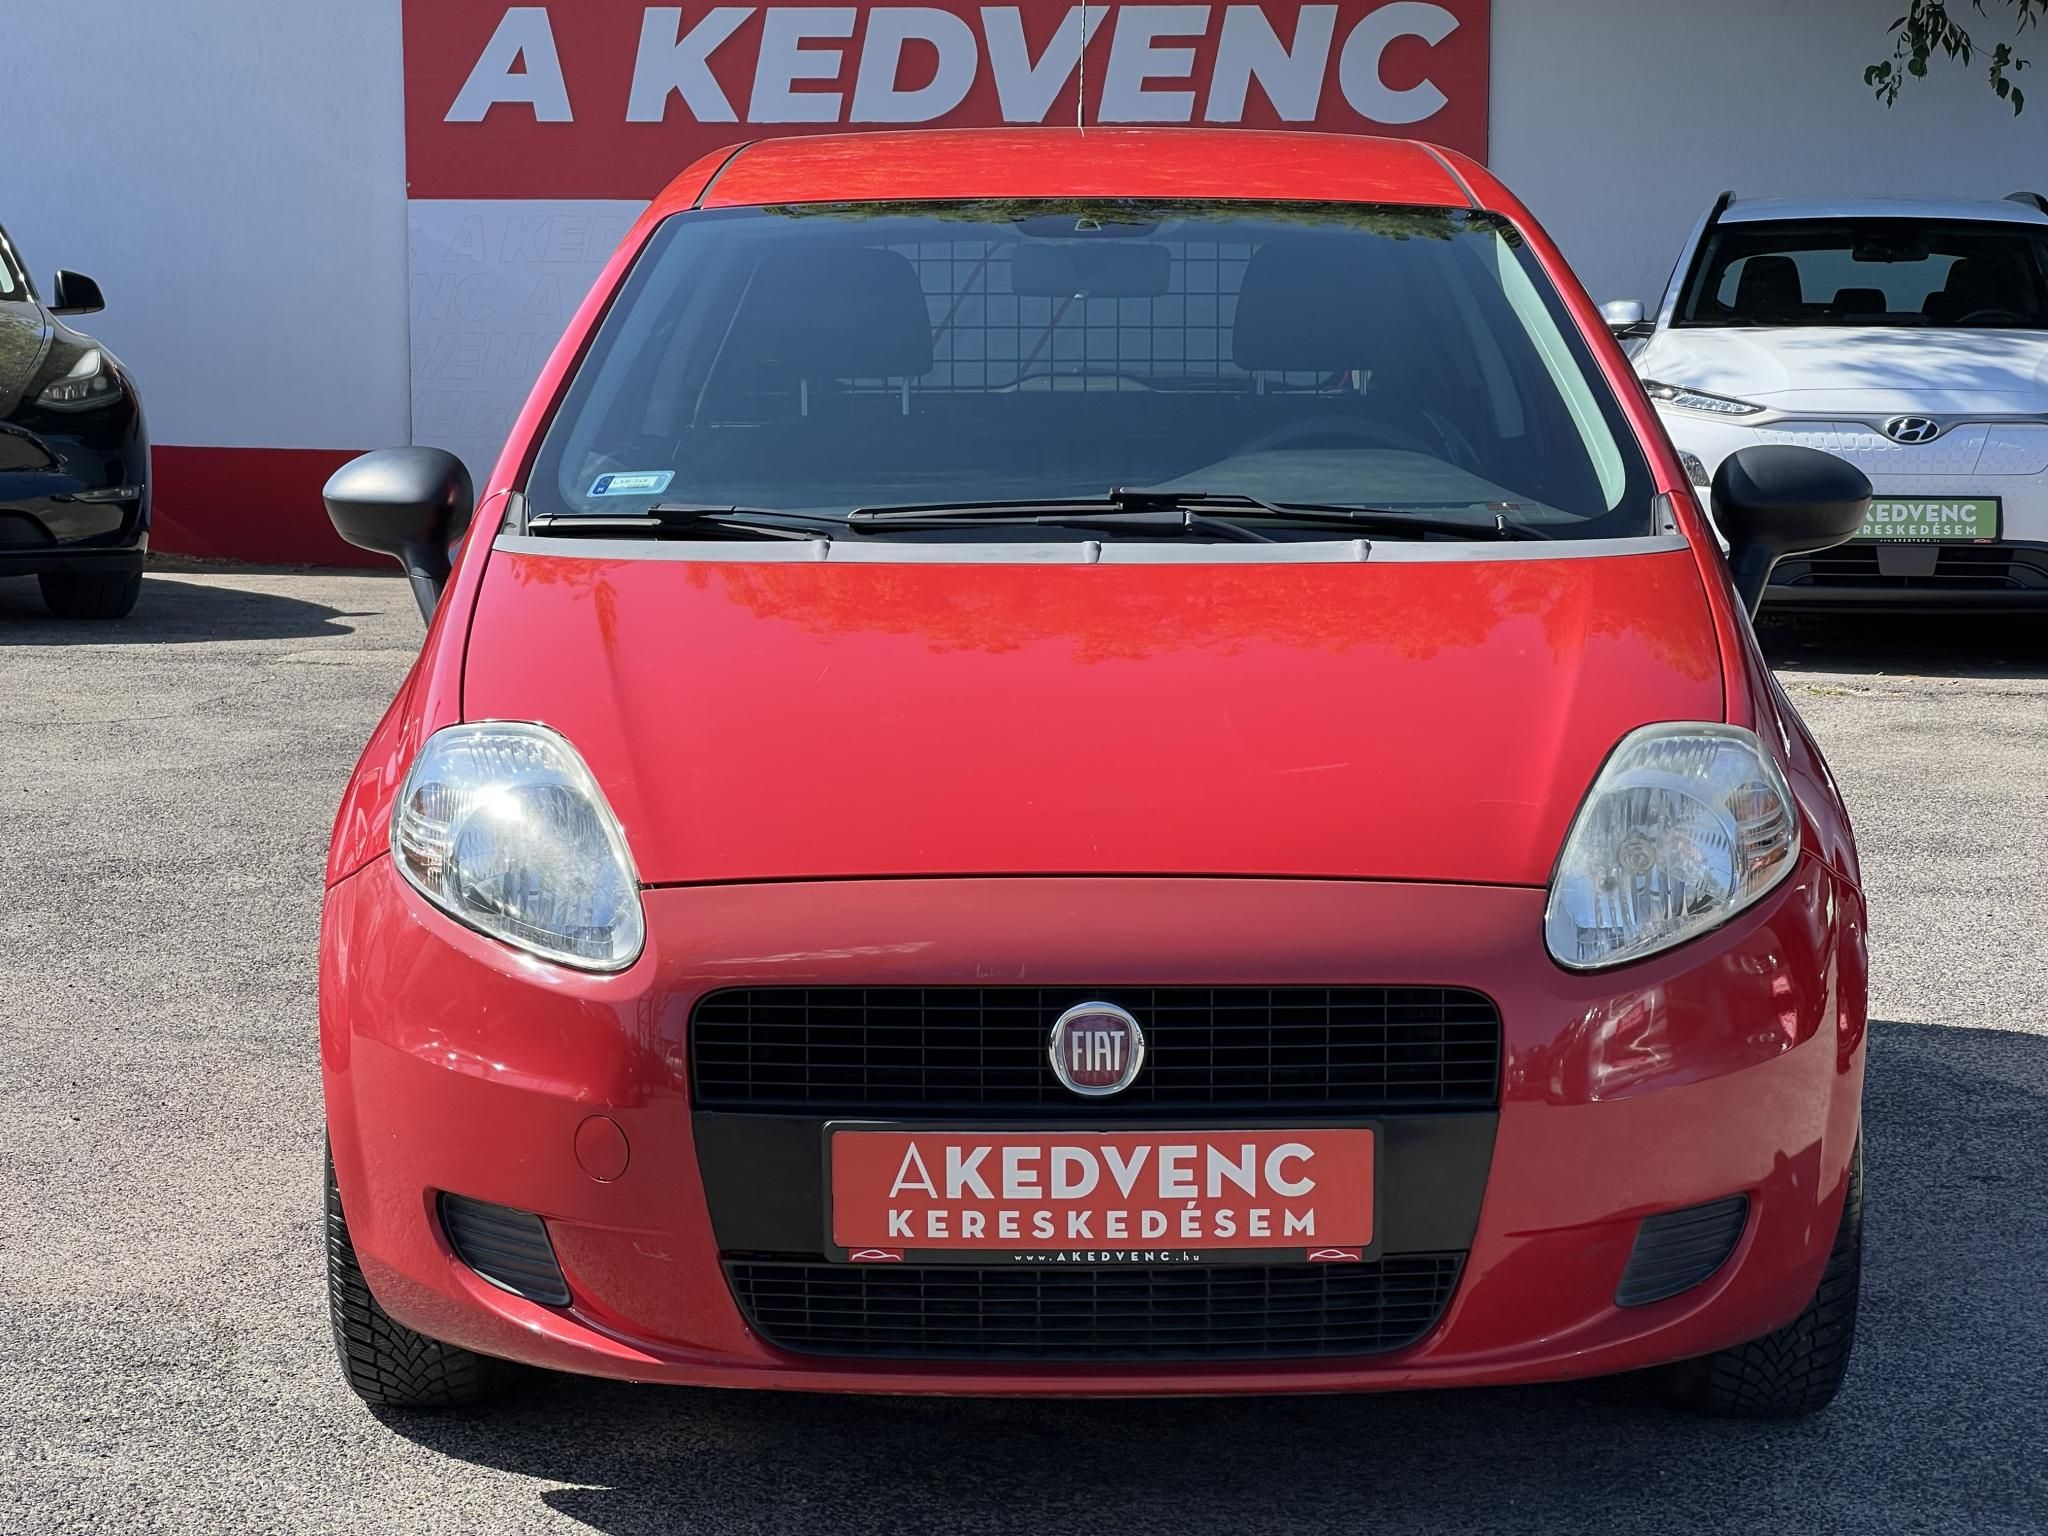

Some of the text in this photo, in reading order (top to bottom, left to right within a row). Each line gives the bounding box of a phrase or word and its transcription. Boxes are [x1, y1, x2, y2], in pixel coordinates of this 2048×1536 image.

[443, 1, 1461, 124] A KEDVENC
[1071, 1030, 1125, 1072] FIAT
[889, 1201, 1316, 1239] KERESKEDÉSEM
